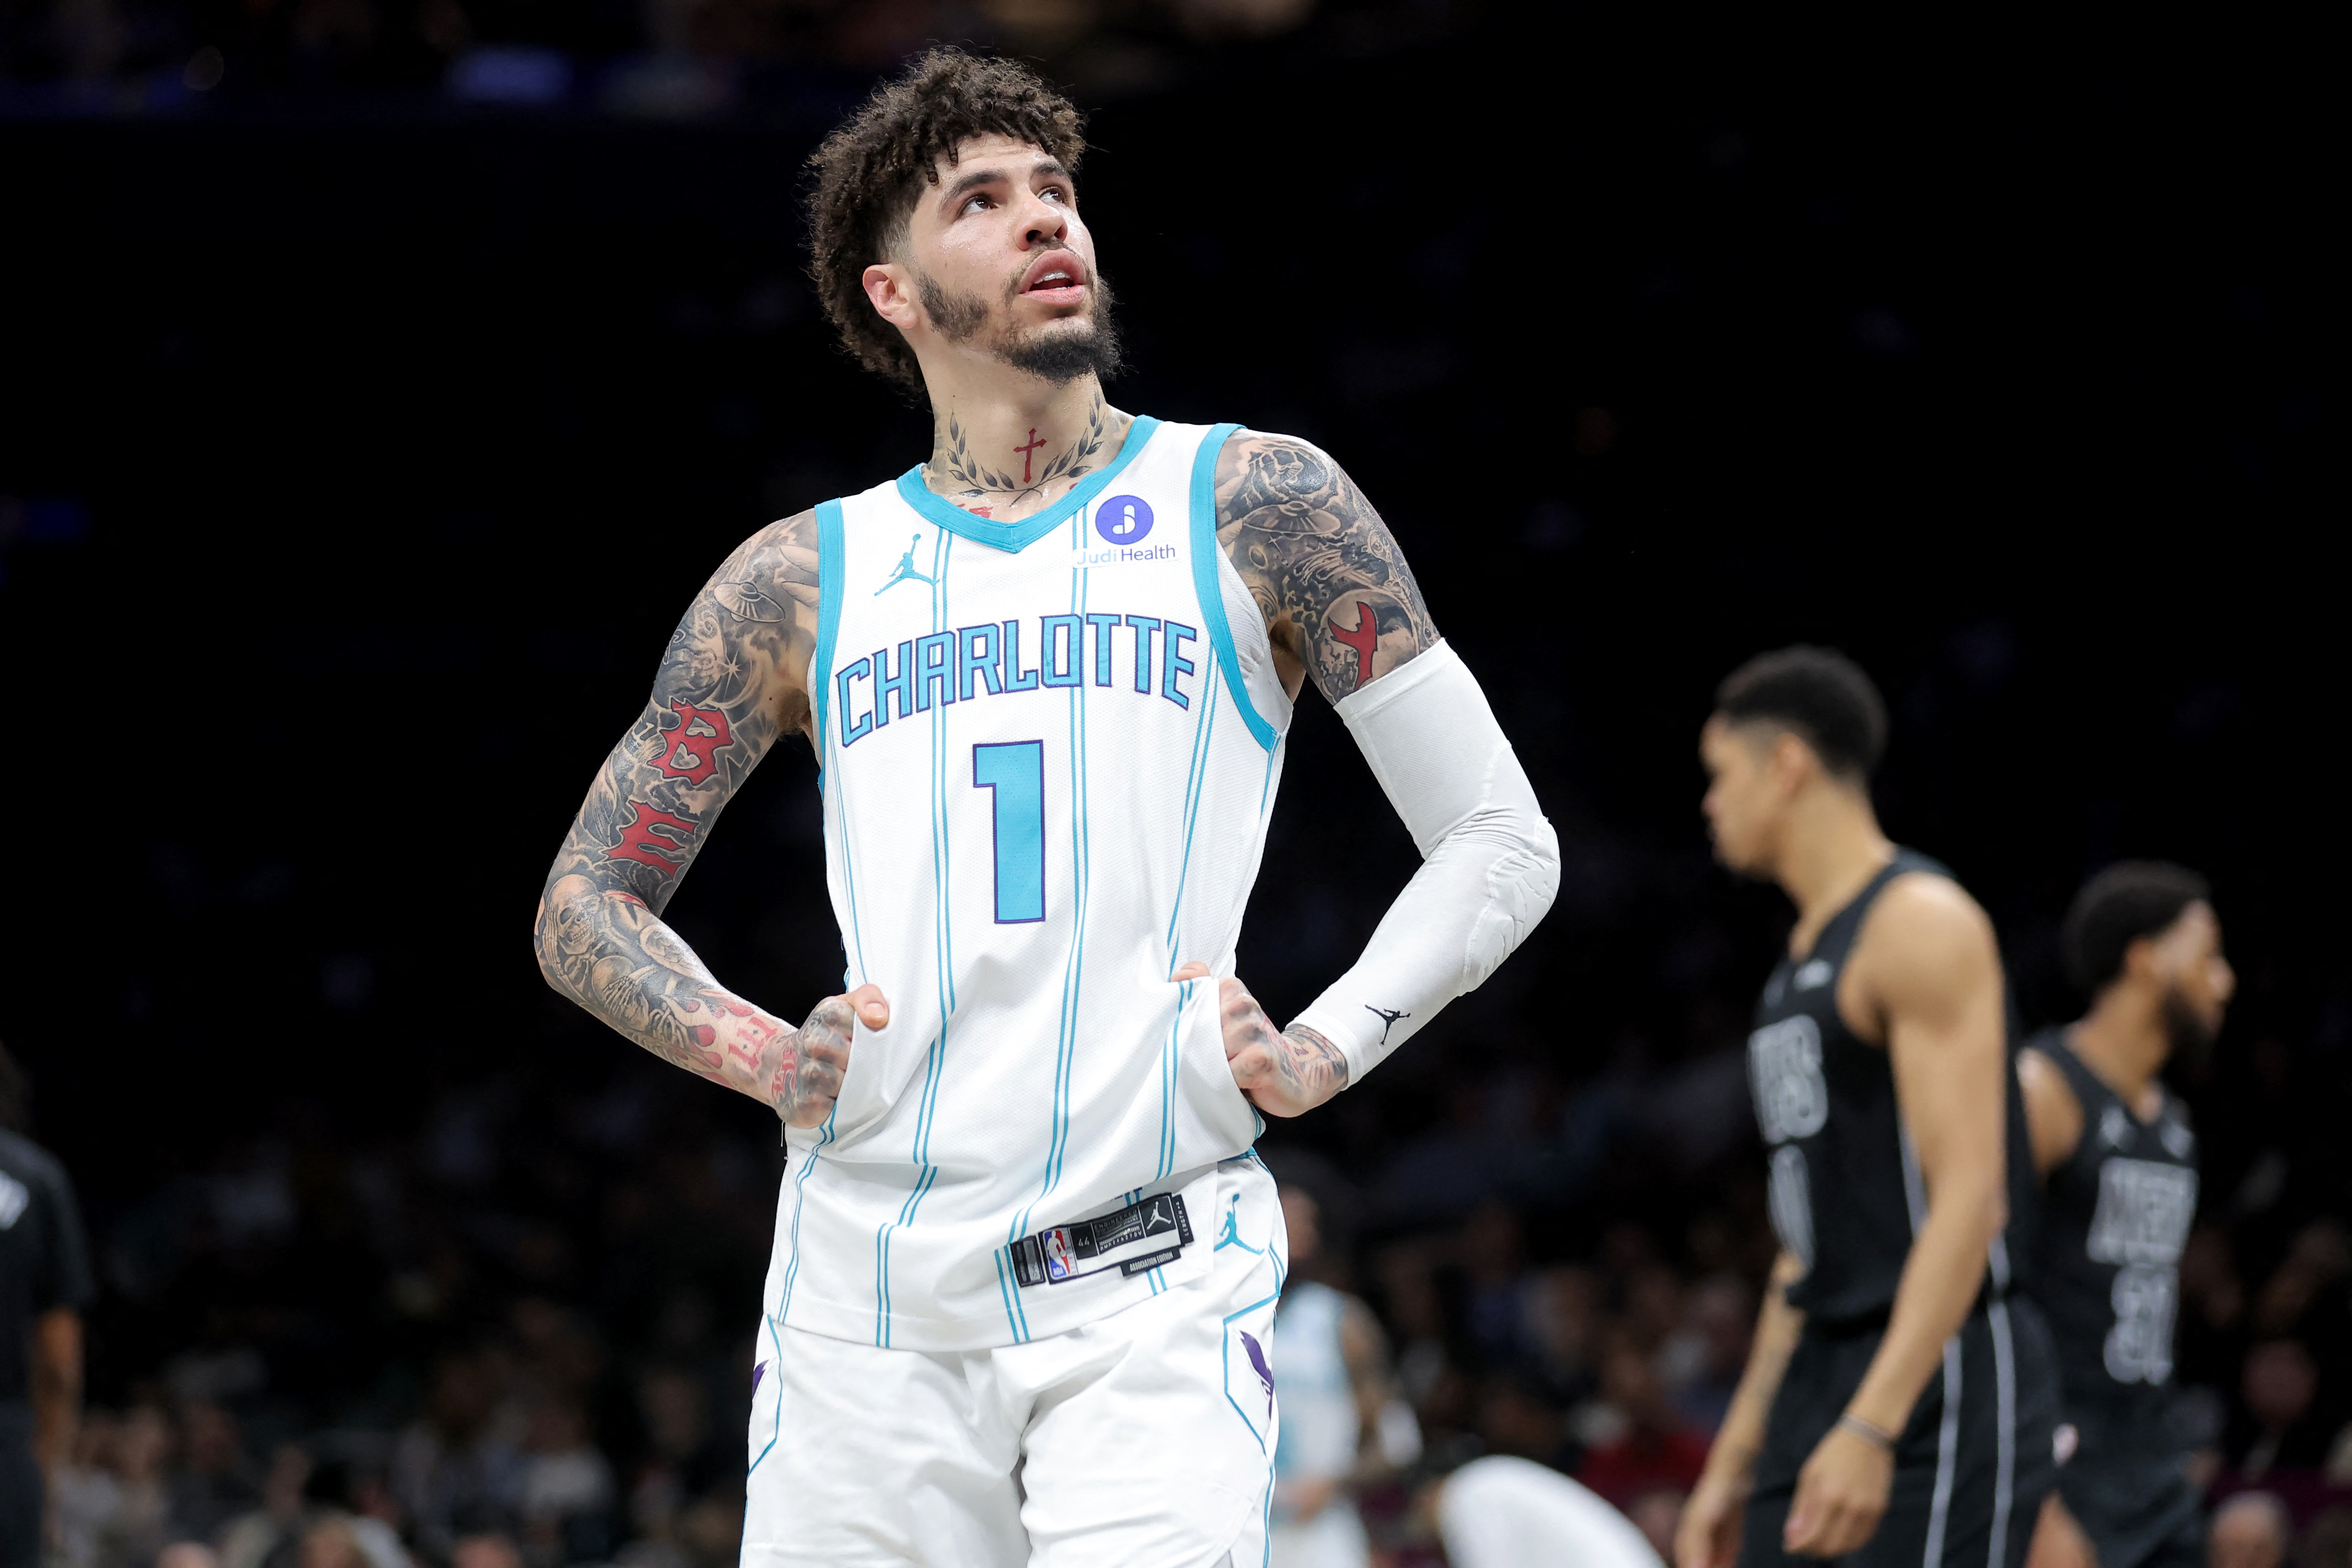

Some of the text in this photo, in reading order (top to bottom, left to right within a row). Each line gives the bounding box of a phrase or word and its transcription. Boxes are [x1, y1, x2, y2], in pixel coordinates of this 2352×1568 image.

[1077, 544, 1175, 565] Judi Health
[836, 613, 1197, 748] CHARLOTTE
[973, 739, 1045, 924] 1
[1130, 1251, 1174, 1272] ASSOCIATION EDITION
[1053, 1267, 1064, 1278] NBA
